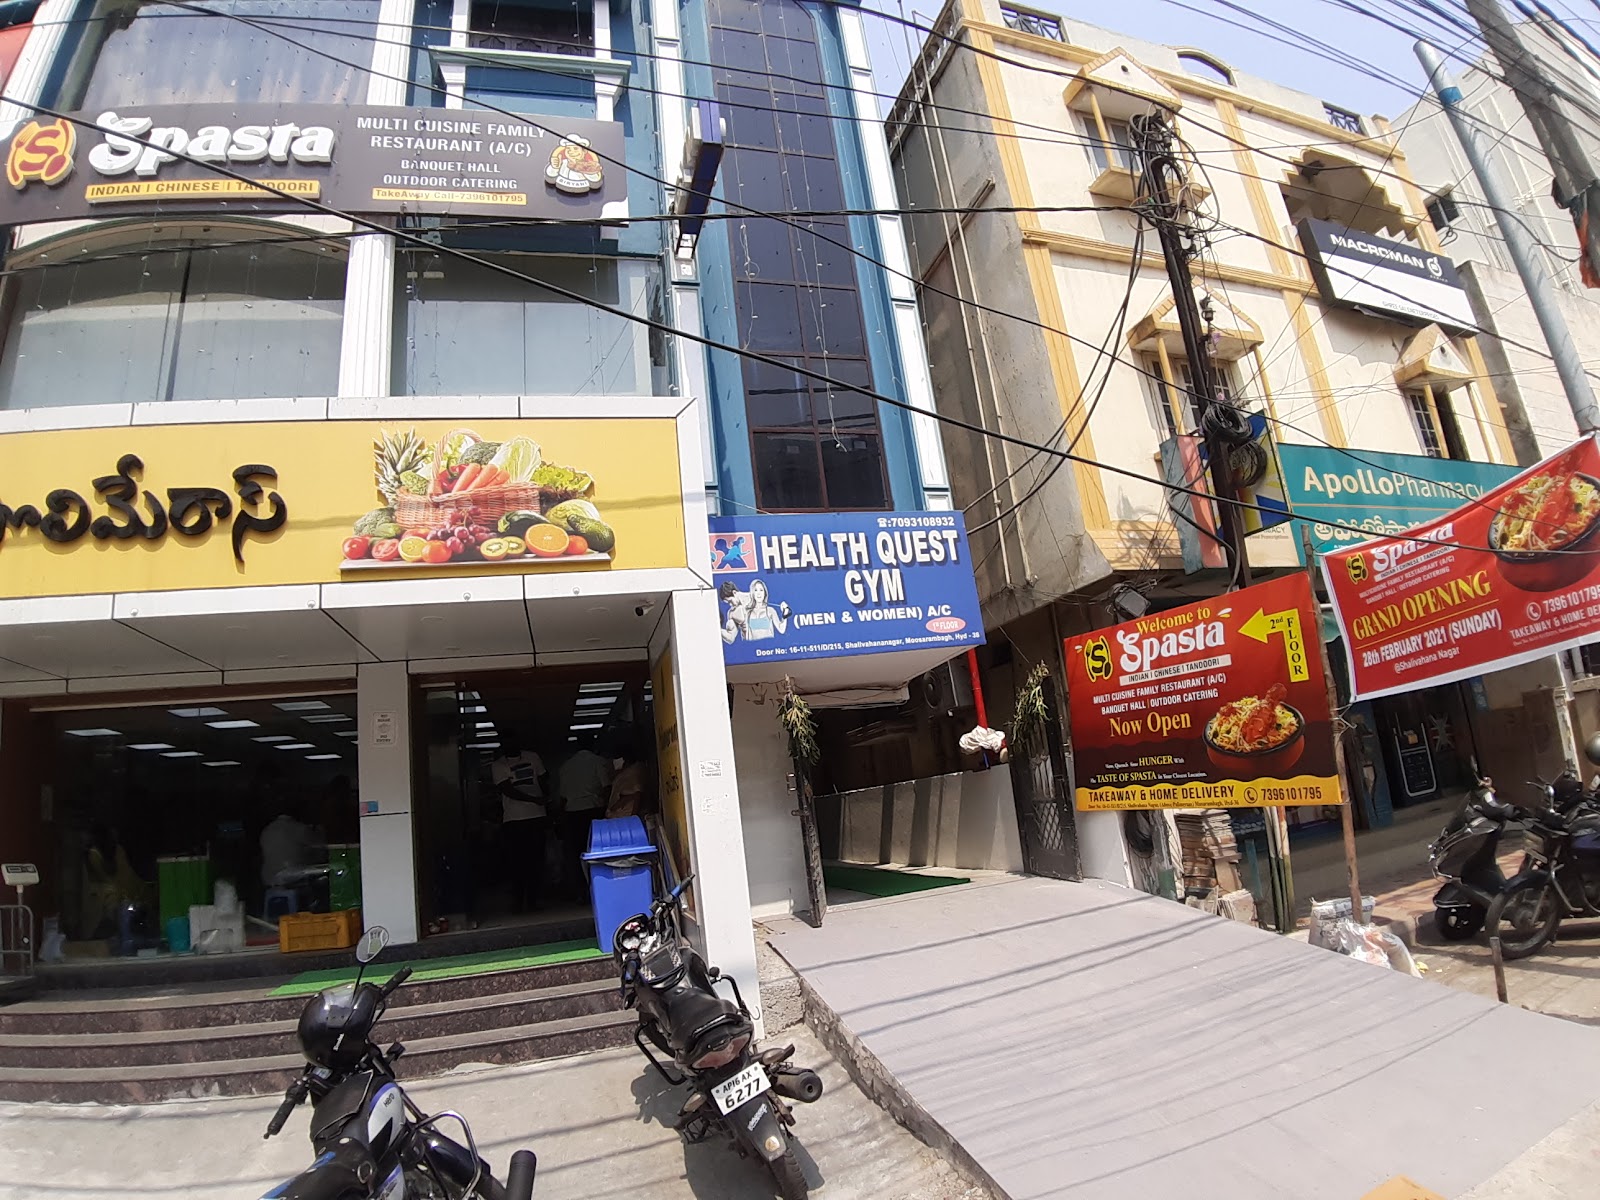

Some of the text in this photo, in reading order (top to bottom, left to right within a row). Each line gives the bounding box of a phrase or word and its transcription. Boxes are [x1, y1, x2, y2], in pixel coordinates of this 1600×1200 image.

[357, 117, 545, 138] MULTI CUISINE FAMILY
[88, 111, 335, 175] Spasta
[371, 135, 531, 157] RESTAURANT (A/C)
[401, 160, 501, 173] BANQUET HALL
[90, 184, 141, 196] INDIAN
[155, 181, 219, 192] CHINESE
[376, 189, 430, 200] TakeAway
[383, 174, 518, 189] OUTDOOR CATERING
[1330, 234, 1425, 269] MACROMAN
[760, 529, 958, 570] HEALTH QUEST
[1370, 523, 1454, 571] Spasta
[1380, 546, 1450, 578] INDIAN CHINESE TANDOORI
[1404, 562, 1438, 580] RESTAURANT
[844, 568, 905, 604] GYM
[1399, 576, 1422, 591] OUTDOOR
[1422, 566, 1450, 581] CATERING
[793, 604, 952, 630] (MEN & WOMEN) A/C
[1352, 570, 1491, 640] GRAND OPENING
[940, 620, 959, 630] FLOOR
[1136, 607, 1211, 635] Welcome to
[1269, 616, 1284, 629] 2nd
[1509, 619, 1552, 639] TAKEAWAY
[1553, 616, 1560, 627] &
[1560, 608, 1586, 625] HOME
[756, 648, 773, 657] Door
[775, 647, 788, 656] No:
[954, 632, 968, 641] Hyd
[1116, 621, 1226, 673] Spasta
[1286, 616, 1304, 675] FLOOR
[1362, 649, 1380, 667] 28th
[1380, 633, 1424, 662] FEBRUARY
[1424, 625, 1448, 648] 2021
[1448, 608, 1502, 644] (SUNDAY)
[1128, 658, 1220, 682] INDIAN CHINESE TANDOORI
[1394, 646, 1460, 674] @Shalivahana Nagar
[1093, 672, 1227, 704] MULTI CUISINE FAMILY RESTAURANT (A/C)
[1101, 688, 1219, 715] BANQUET HALL OUTDOOR CATERING
[1109, 711, 1192, 737] Now Open
[1139, 755, 1174, 767] HUNGER
[1096, 774, 1118, 783] TASTE
[1118, 772, 1129, 782] OF
[1130, 770, 1157, 781] SPASTA
[1088, 785, 1235, 802] TAKEAWAY & HOME DELIVERY
[1261, 786, 1322, 801] 7396101795
[722, 1071, 752, 1093] AP16 AX
[725, 1078, 760, 1108] 6277
